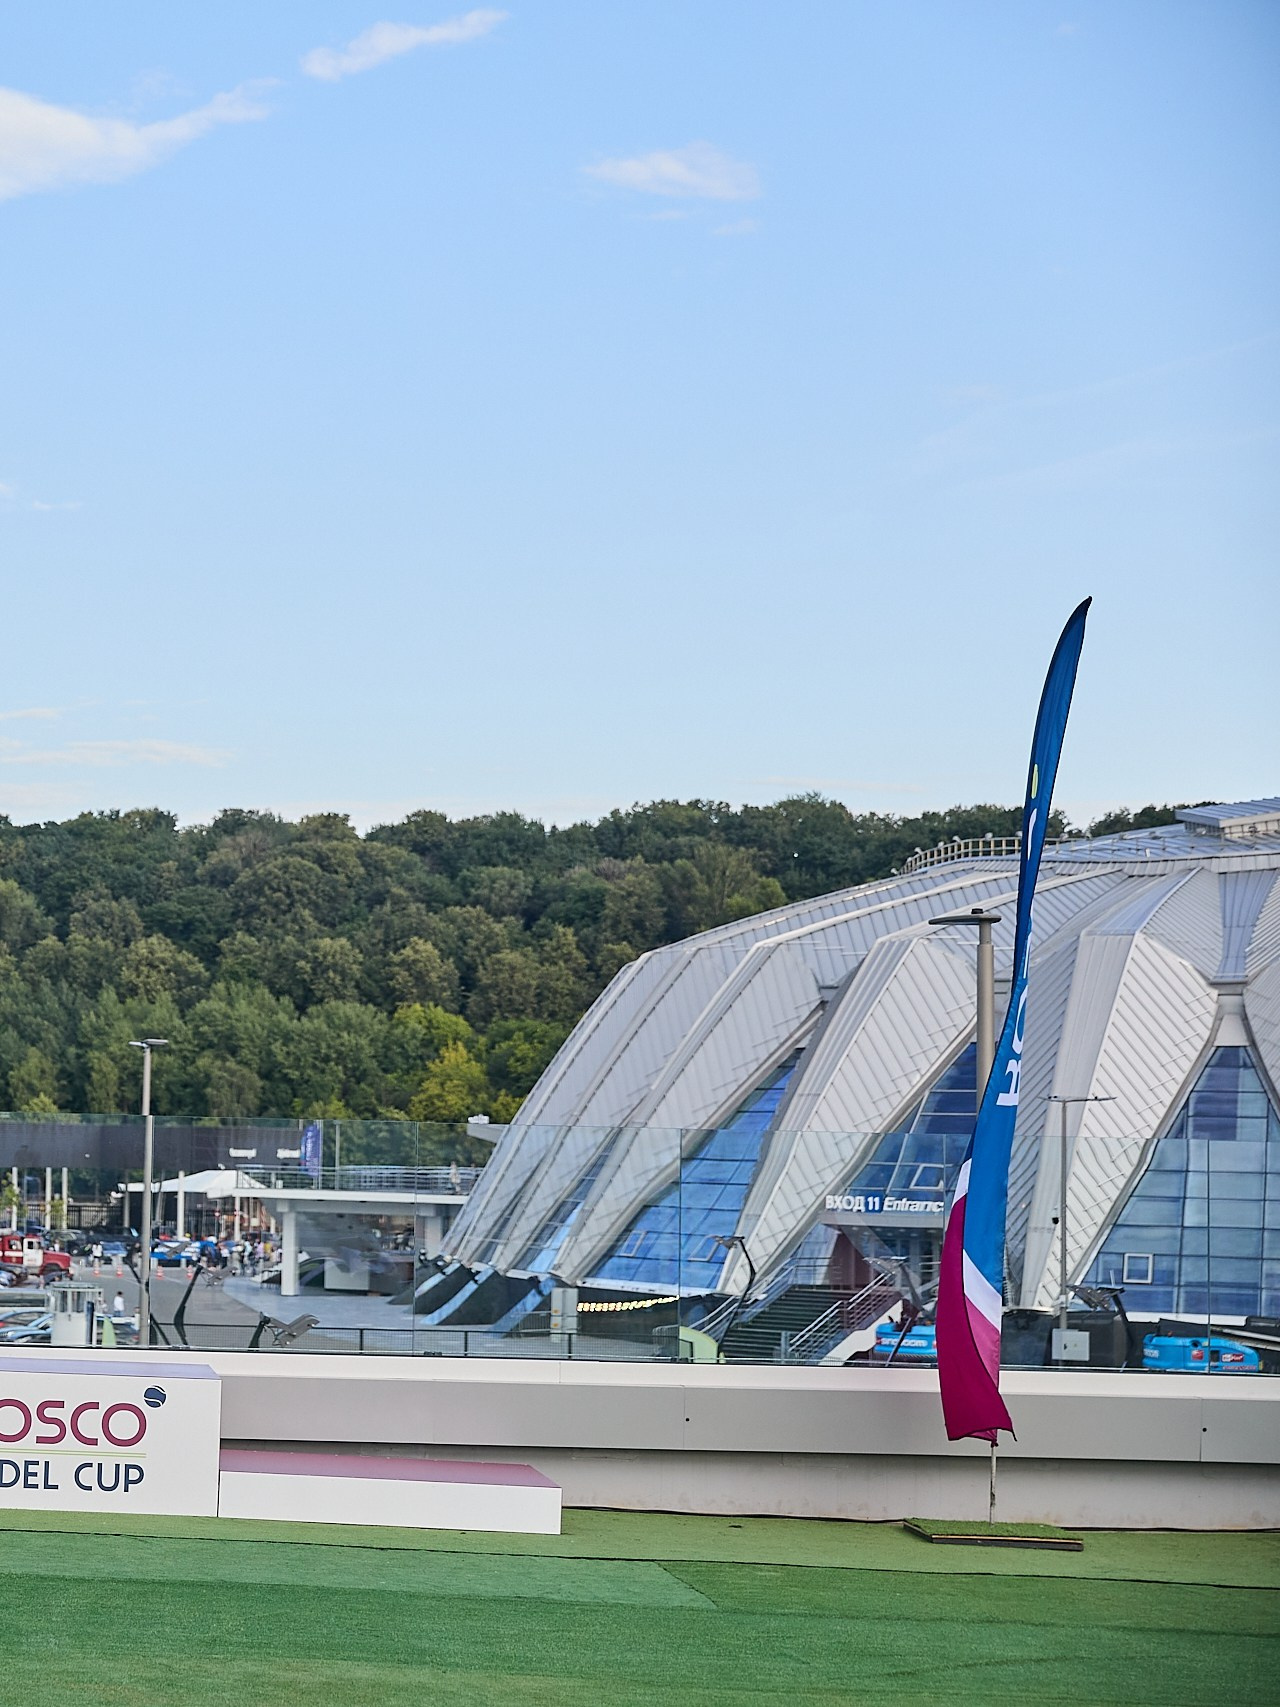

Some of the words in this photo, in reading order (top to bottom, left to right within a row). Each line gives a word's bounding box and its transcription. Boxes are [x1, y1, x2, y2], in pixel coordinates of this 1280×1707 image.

[825, 1195, 865, 1212] ВХОД
[867, 1196, 880, 1211] 11
[882, 1197, 944, 1213] Entranc
[74, 1462, 145, 1493] CUP
